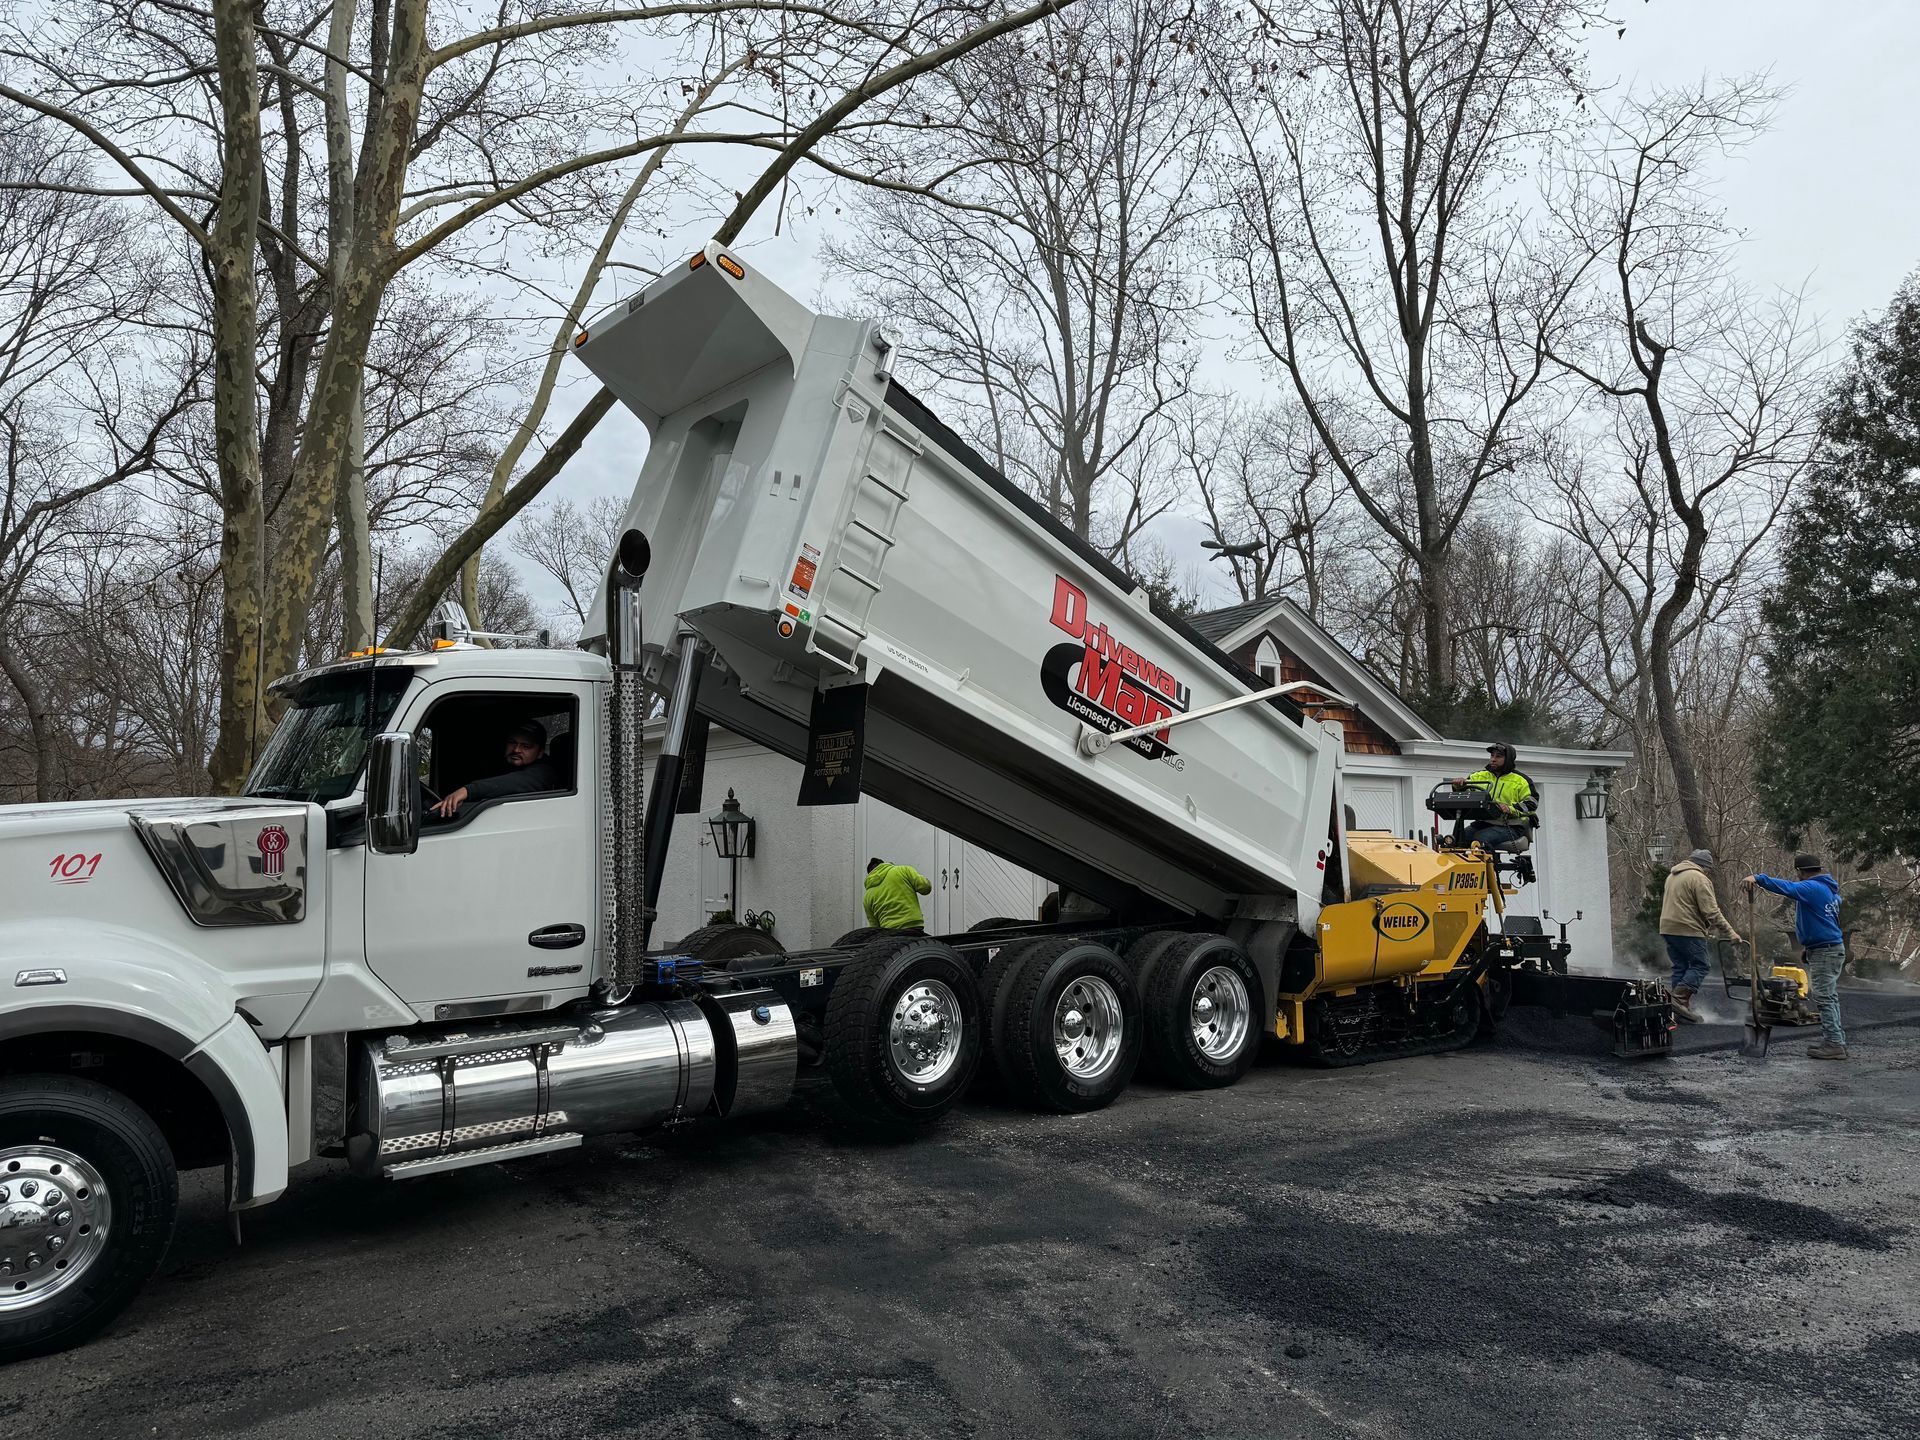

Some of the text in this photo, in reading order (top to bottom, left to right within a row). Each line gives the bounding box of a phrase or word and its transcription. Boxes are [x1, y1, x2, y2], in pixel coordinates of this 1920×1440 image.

[1049, 573, 1191, 713] Driveway
[1075, 643, 1173, 744] Man
[1066, 695, 1110, 728] Licensed
[1109, 721, 1118, 732] &
[1118, 725, 1153, 753] Iured
[816, 735, 856, 749] TRIAD TRUCK
[816, 749, 853, 762] EQUIPMENT
[1160, 751, 1185, 772] LLC
[49, 853, 103, 879] 101
[1383, 915, 1419, 928] WEILER
